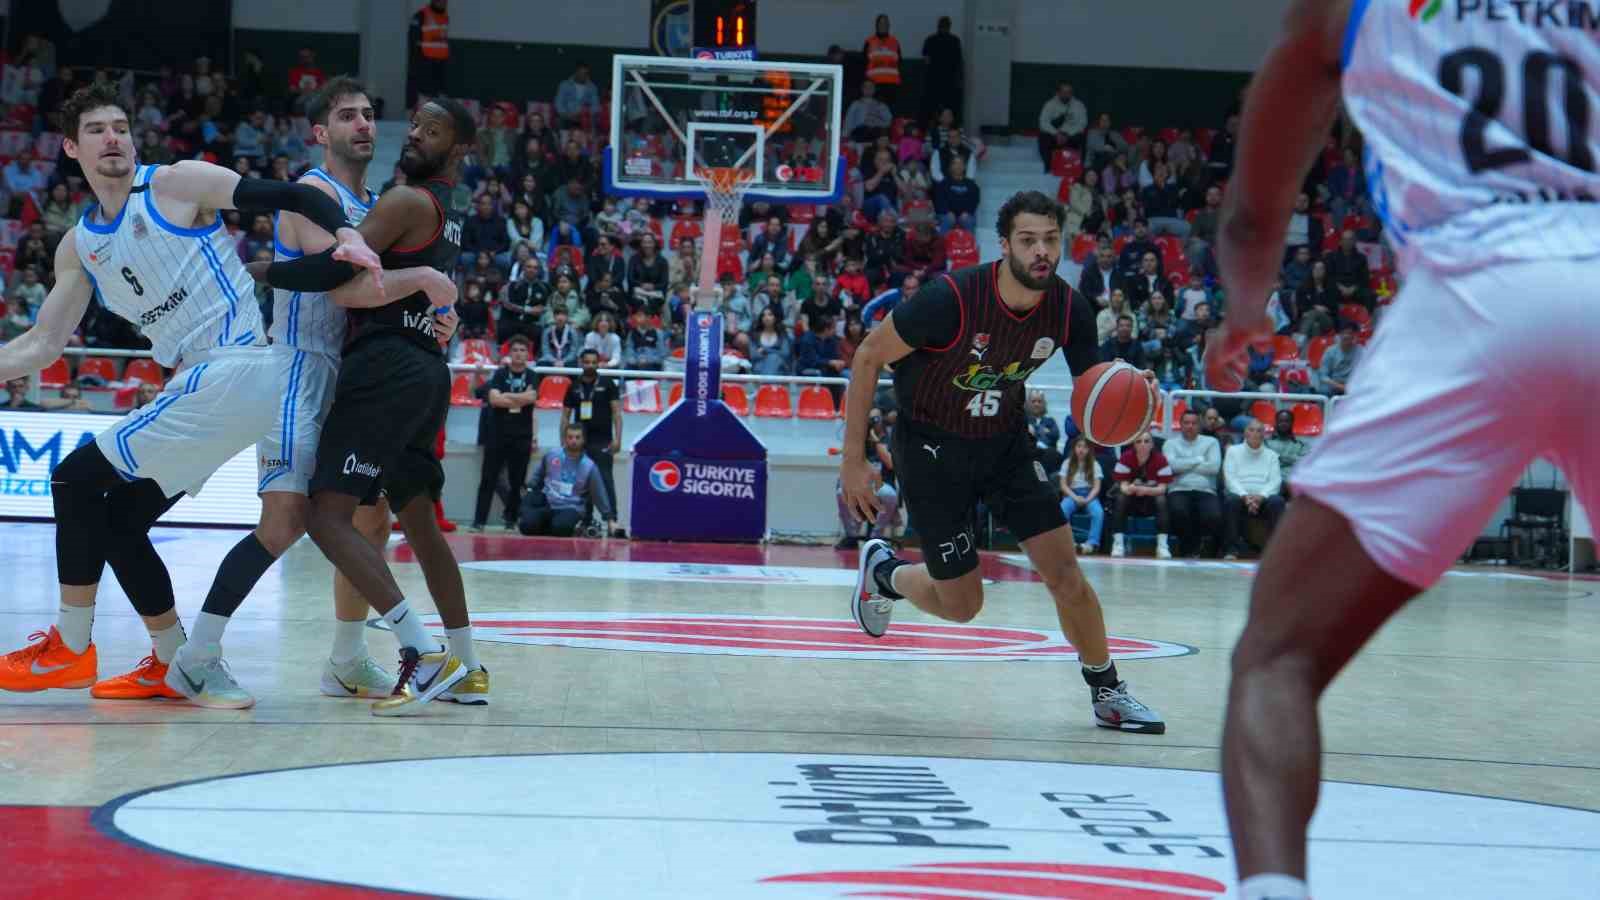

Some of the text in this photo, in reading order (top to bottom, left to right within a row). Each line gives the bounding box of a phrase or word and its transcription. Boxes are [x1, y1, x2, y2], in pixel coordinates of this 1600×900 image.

[716, 15, 743, 46] 11
[1438, 47, 1597, 175] 20
[121, 266, 144, 297] 6
[965, 389, 1002, 417] 45
[1040, 791, 1225, 858] SPOR
